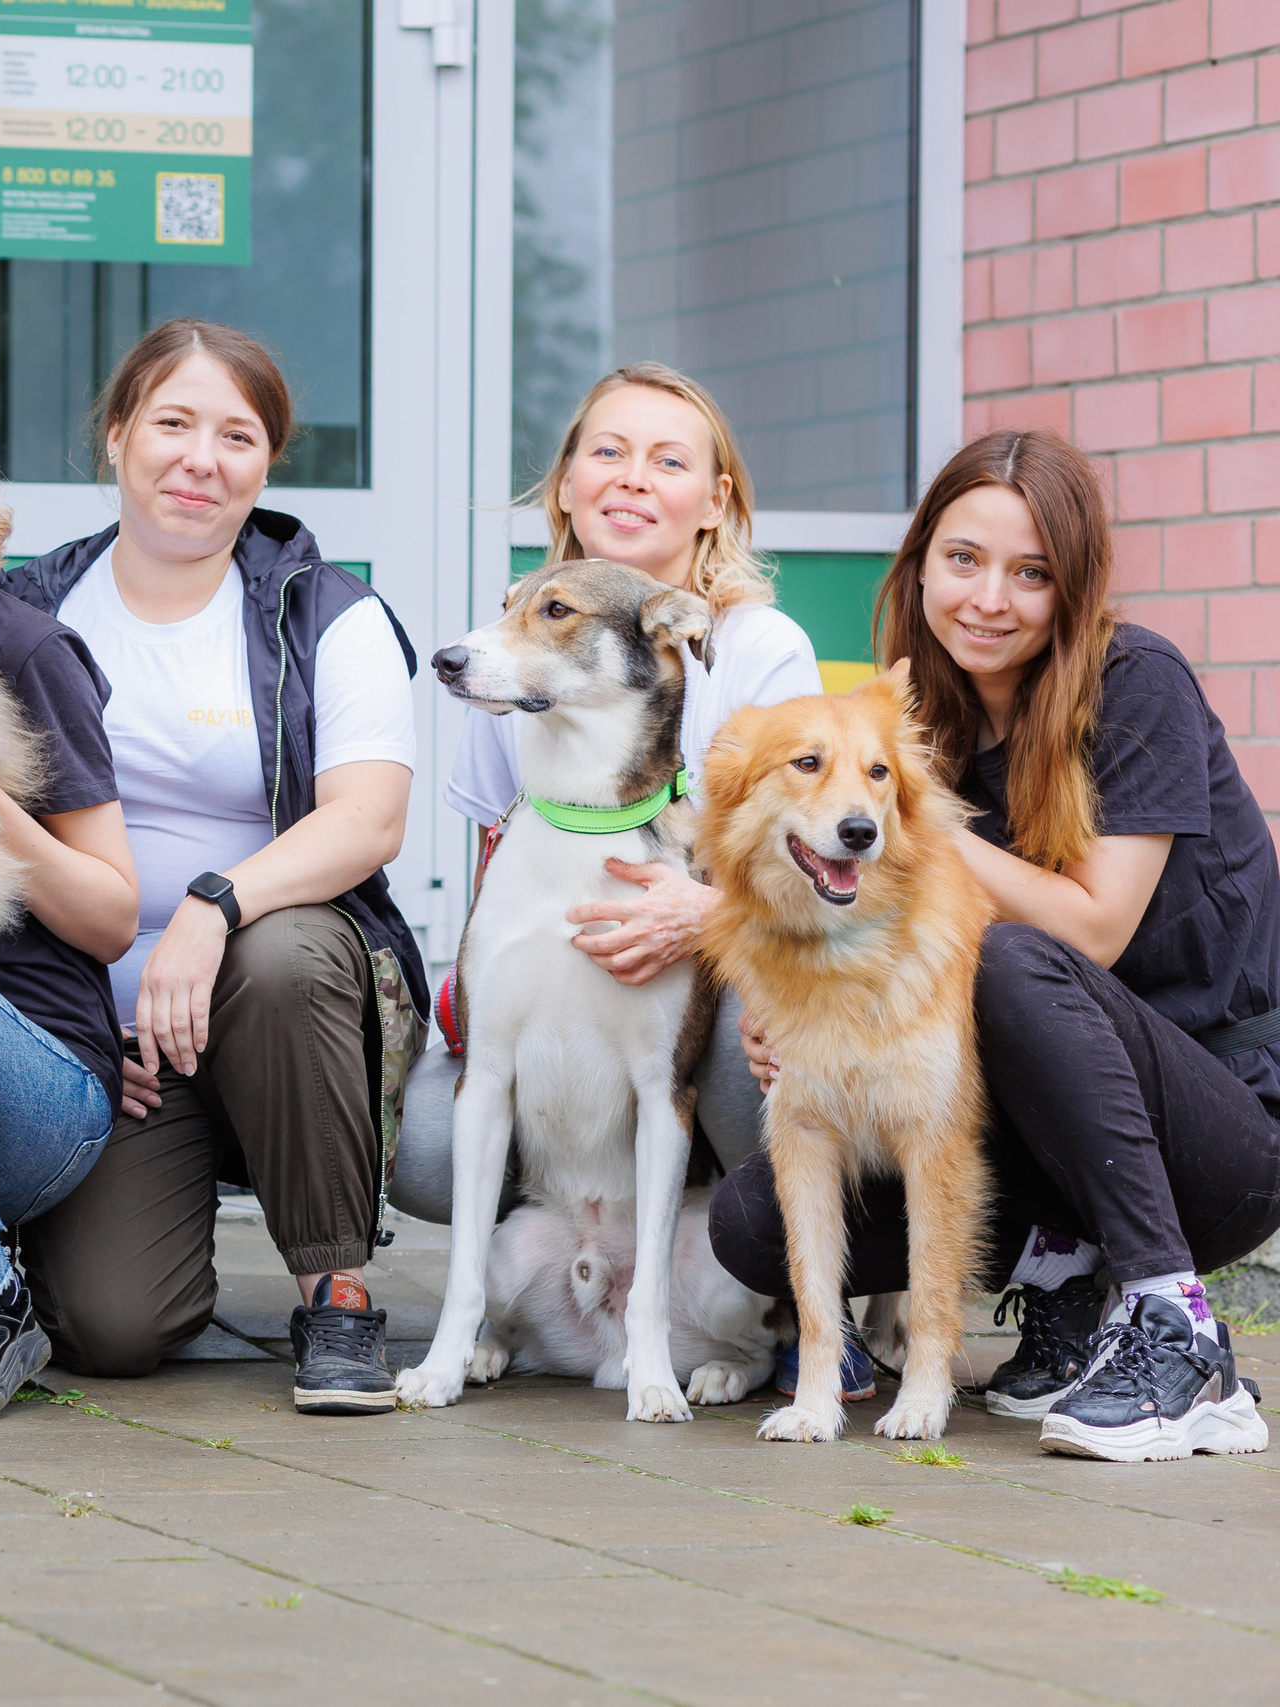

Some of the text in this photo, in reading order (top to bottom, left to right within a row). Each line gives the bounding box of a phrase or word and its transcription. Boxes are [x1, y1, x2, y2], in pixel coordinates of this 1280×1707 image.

[2, 166, 14, 184] 8
[16, 166, 46, 185] 800
[49, 168, 70, 186] 101
[72, 169, 94, 187] 89
